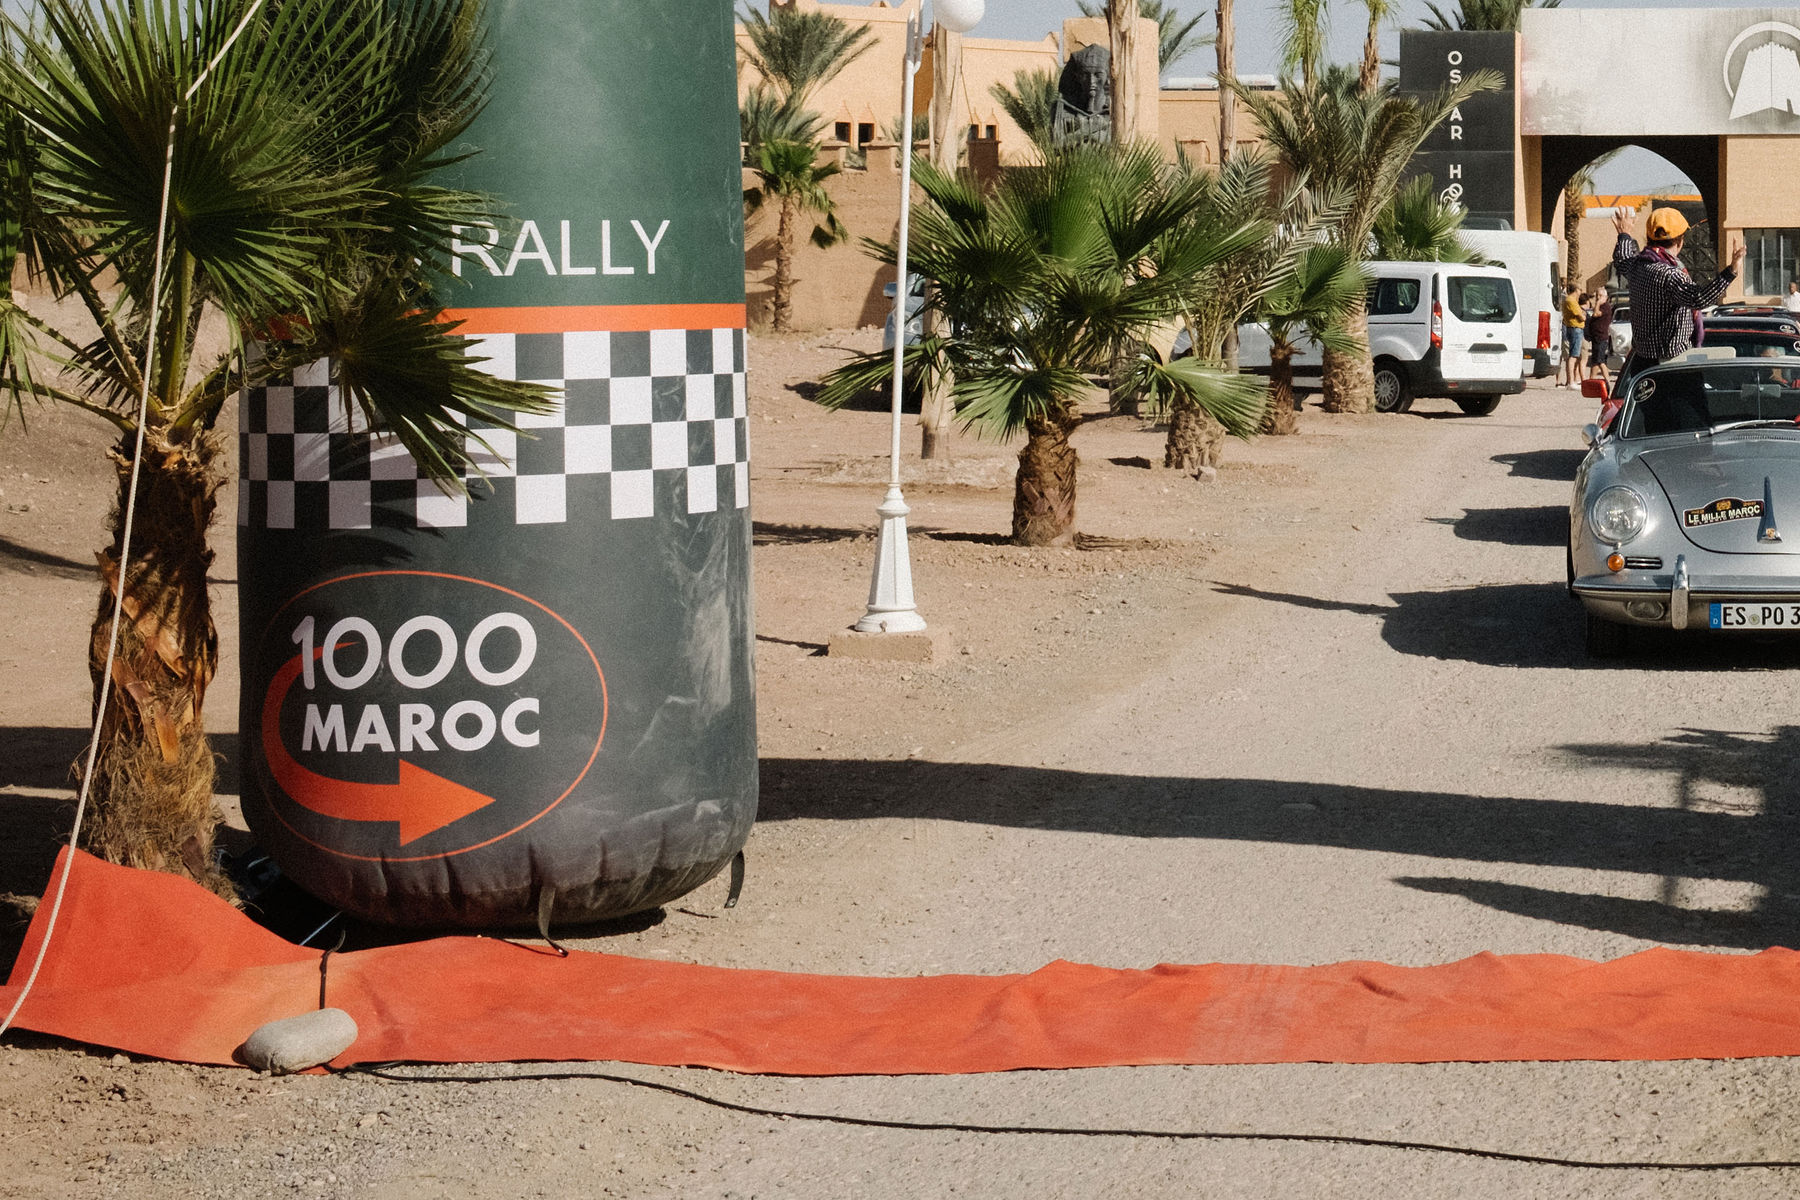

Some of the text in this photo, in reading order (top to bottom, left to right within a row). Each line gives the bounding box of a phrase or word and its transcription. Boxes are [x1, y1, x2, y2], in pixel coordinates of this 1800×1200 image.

[1447, 50, 1463, 140] OSAR
[451, 219, 671, 277] RALLY
[1688, 513, 1700, 524] LE
[1701, 510, 1727, 522] MILLE
[1728, 504, 1761, 517] MAROC
[1722, 606, 1747, 625] ES
[1761, 606, 1785, 625] PO
[292, 612, 538, 691] 1000
[301, 698, 540, 753] MAROC
